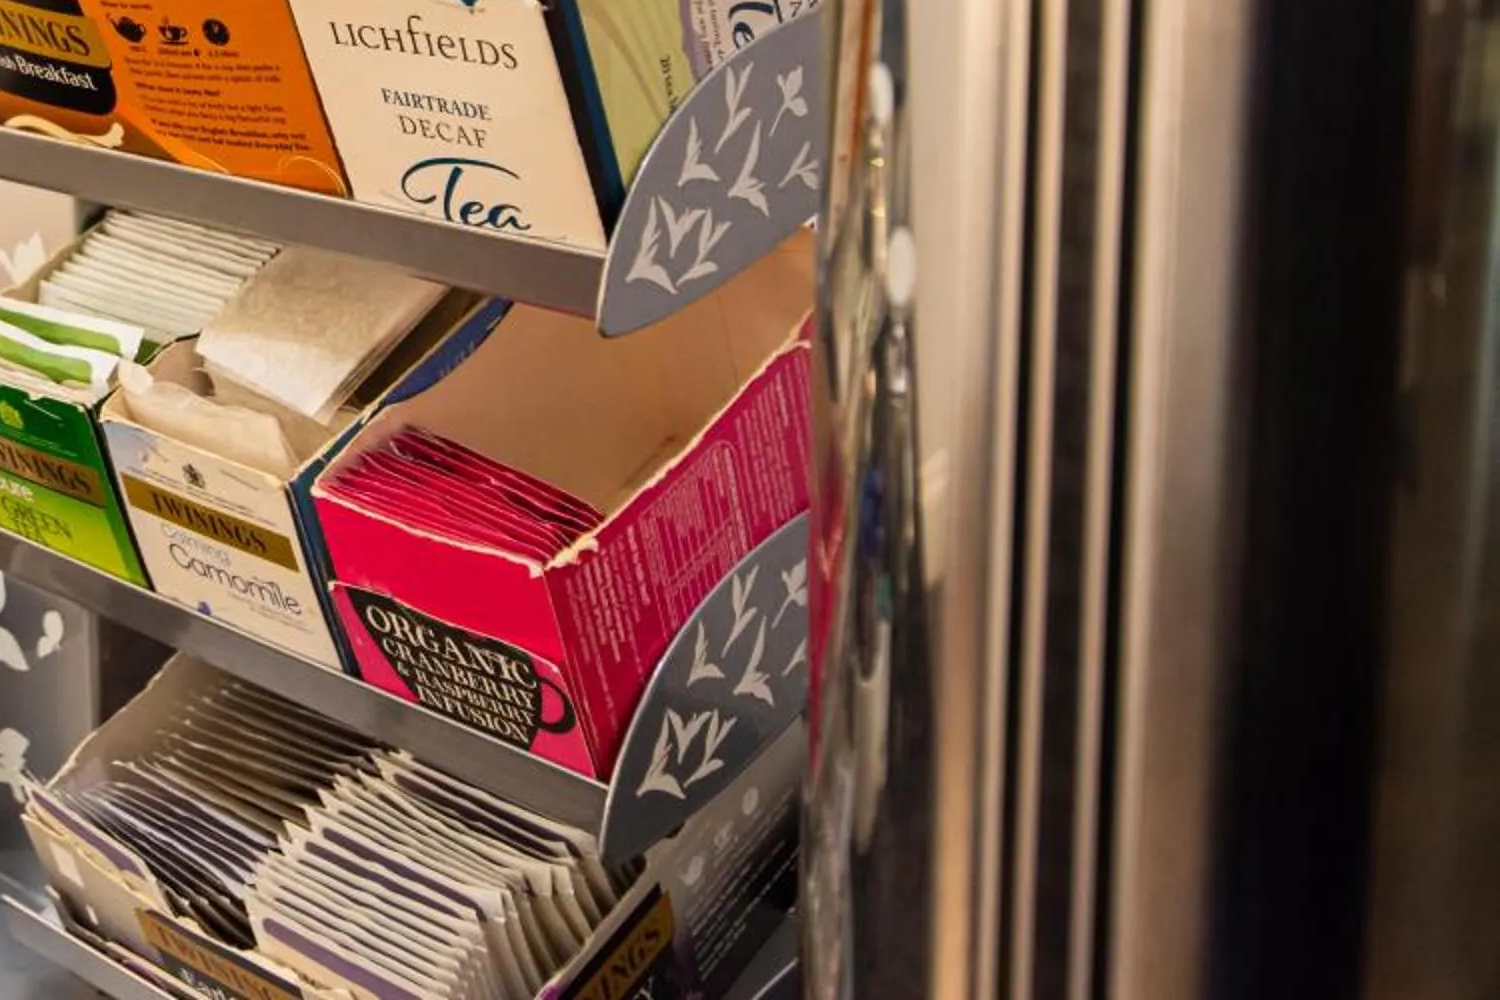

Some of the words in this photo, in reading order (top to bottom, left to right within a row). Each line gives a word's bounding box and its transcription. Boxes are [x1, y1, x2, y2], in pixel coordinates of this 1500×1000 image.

[16, 53, 99, 91] Breakfast
[381, 87, 492, 121] FAIRTRADE
[399, 114, 487, 148] DECAF
[401, 157, 532, 230] Tea
[150, 491, 267, 553] TWININGS
[365, 604, 538, 689] ORGANIC
[382, 636, 535, 710] CRANBERRY
[414, 667, 536, 727] RASPBERRY
[417, 683, 530, 744] INFUSION
